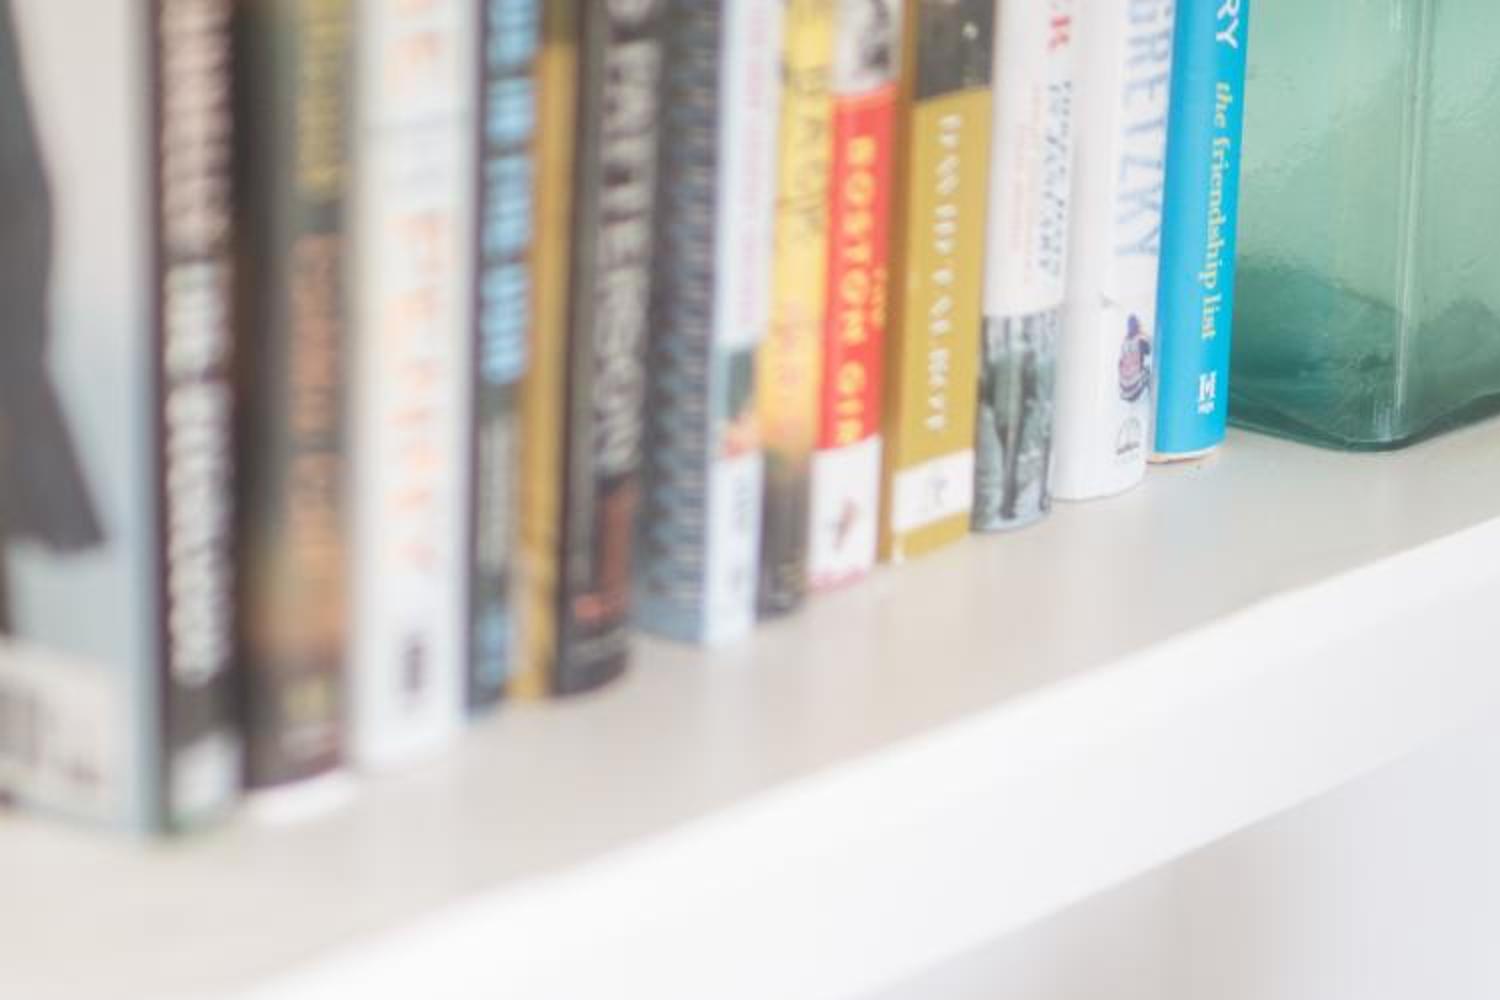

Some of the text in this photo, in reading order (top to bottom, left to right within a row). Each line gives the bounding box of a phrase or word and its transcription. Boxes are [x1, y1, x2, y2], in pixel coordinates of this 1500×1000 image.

[594, 36, 661, 477] PATTERSON
[838, 135, 876, 347] BOSTON
[1198, 81, 1233, 341] the friendship list
